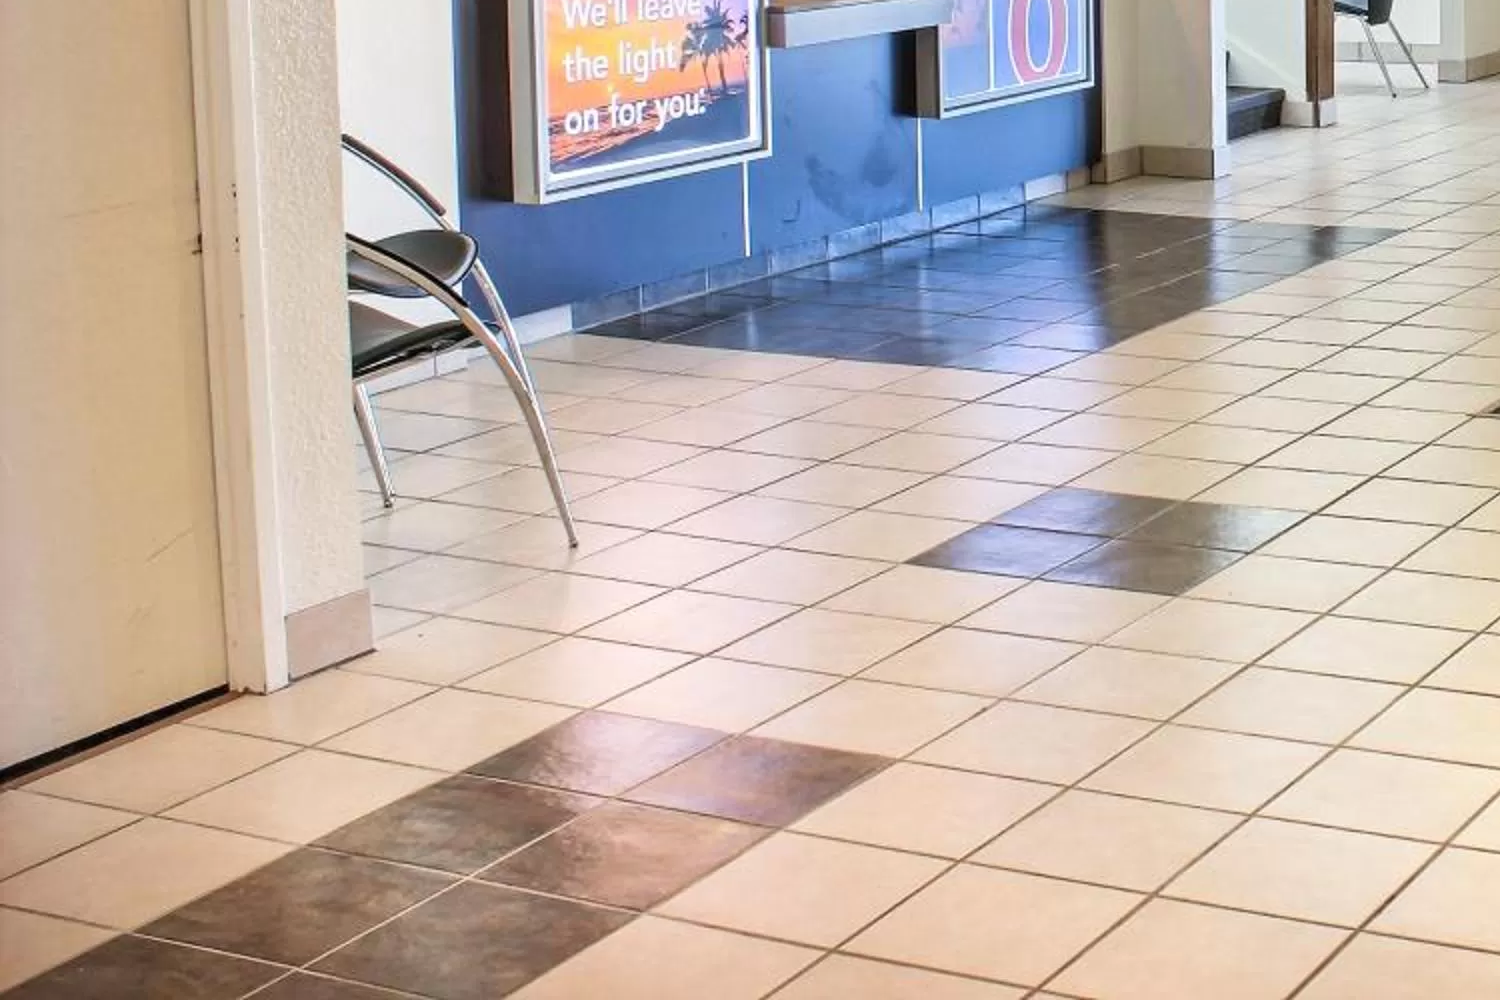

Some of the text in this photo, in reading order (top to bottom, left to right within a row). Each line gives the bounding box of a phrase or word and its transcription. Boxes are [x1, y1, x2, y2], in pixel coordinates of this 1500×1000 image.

[562, 37, 678, 83] the light
[564, 106, 600, 135] on
[608, 92, 649, 128] for
